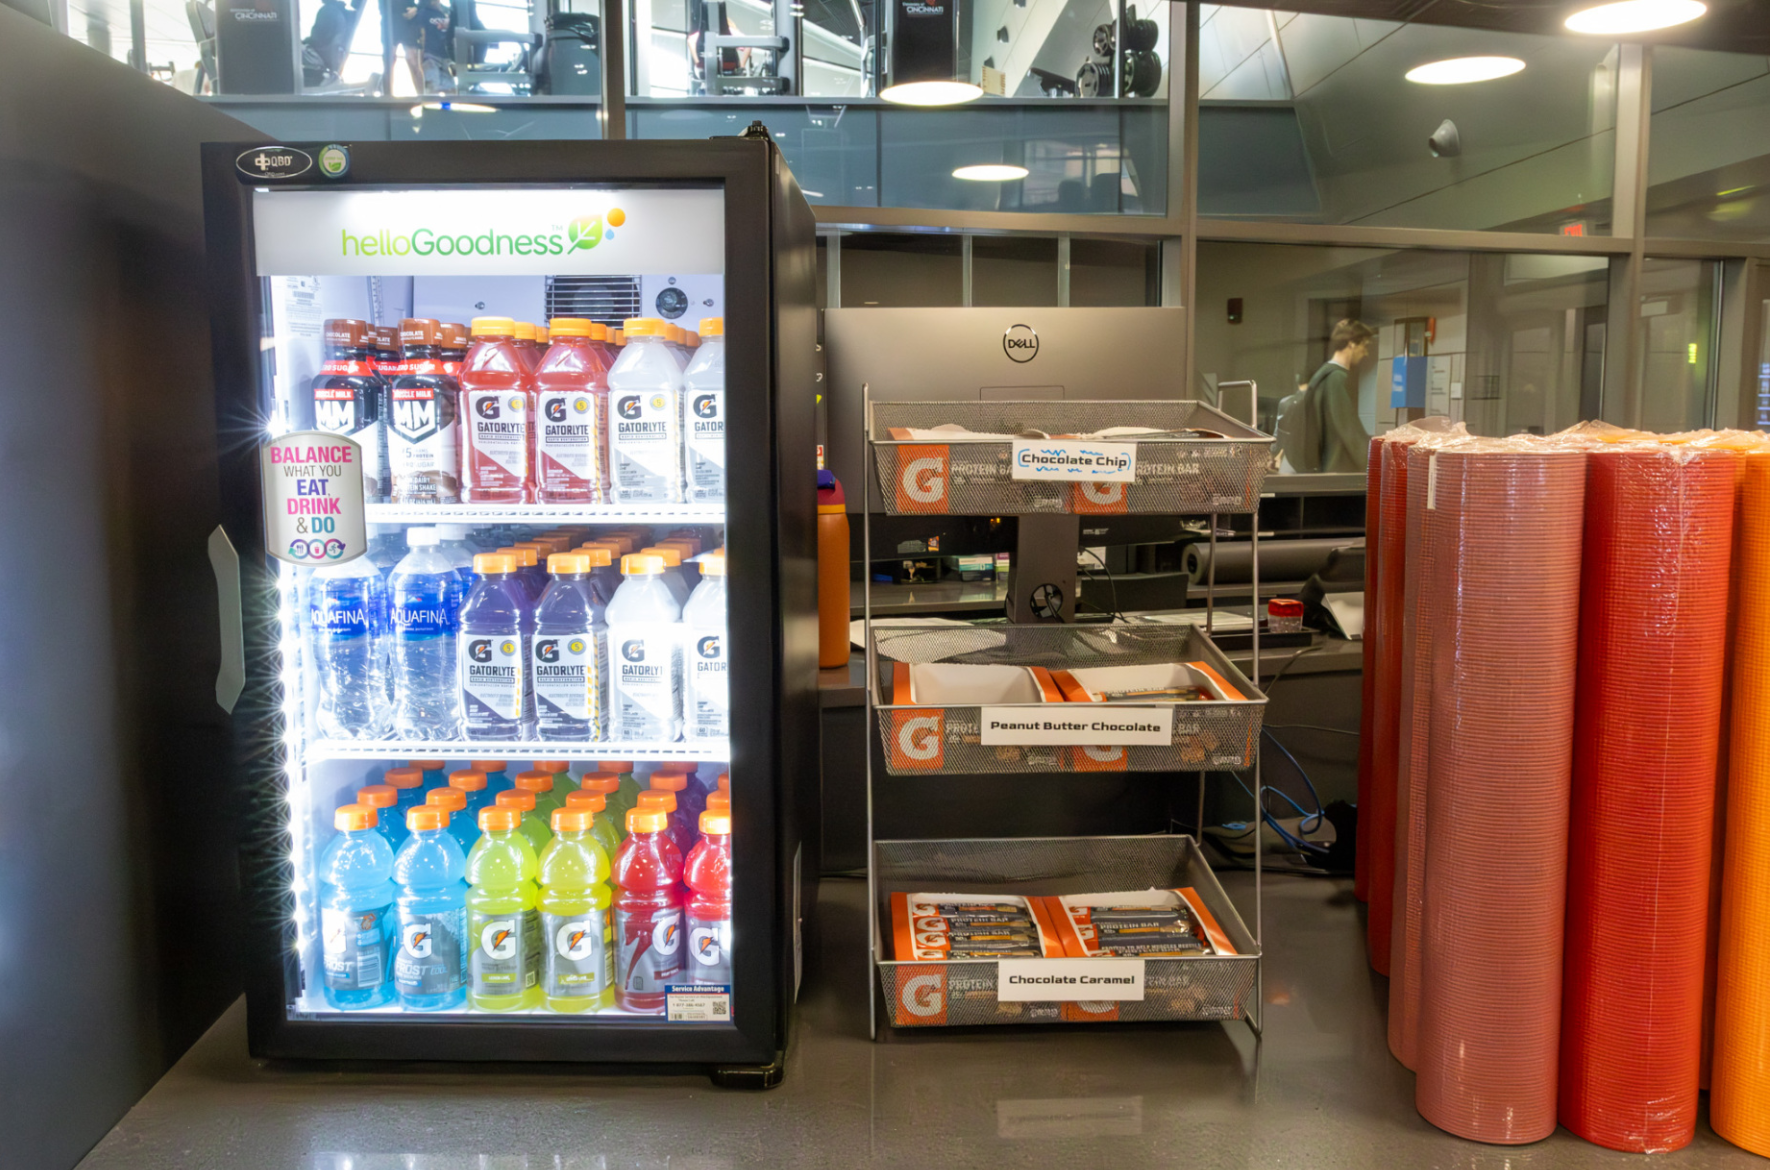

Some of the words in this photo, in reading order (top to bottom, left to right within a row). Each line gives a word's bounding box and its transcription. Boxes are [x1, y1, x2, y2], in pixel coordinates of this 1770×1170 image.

[342, 228, 563, 257] helloGoodness
[1008, 338, 1036, 349] DELL
[415, 390, 431, 398] MILK
[475, 396, 501, 420] G
[545, 398, 567, 422] G
[617, 395, 642, 420] G
[693, 394, 717, 419] G
[477, 421, 525, 433] GATORLYTE
[545, 425, 588, 435] GATORLYTE
[618, 422, 667, 433] GATORLYTE
[270, 446, 353, 464] BALANCE
[1021, 454, 1093, 466] Chocolate
[1096, 456, 1127, 469] Chip
[283, 465, 316, 477] WHAT
[319, 465, 342, 477] YOU
[902, 457, 944, 504] G
[296, 479, 331, 497] EAT,
[287, 498, 342, 515] DRINK
[296, 517, 308, 534] &
[311, 516, 336, 534] DO
[390, 608, 450, 627] AQUAFINA
[468, 639, 492, 663] G
[535, 639, 560, 663] G
[621, 639, 645, 662] G
[696, 635, 720, 659] G
[469, 665, 515, 676] GATORLYTE
[536, 665, 585, 676] GATORLYTE
[990, 721, 1040, 730] Peanut
[1043, 722, 1088, 731] Butter
[1091, 722, 1161, 732] Chocolate
[899, 716, 940, 760] G
[403, 923, 432, 959] G
[481, 919, 516, 960] G
[556, 919, 592, 961] G
[652, 912, 680, 956] G
[689, 927, 719, 967] G
[693, 985, 725, 993] Advantage
[1009, 974, 1077, 985] Chocolate
[1079, 975, 1135, 985] Caramel
[902, 974, 943, 1017] G
